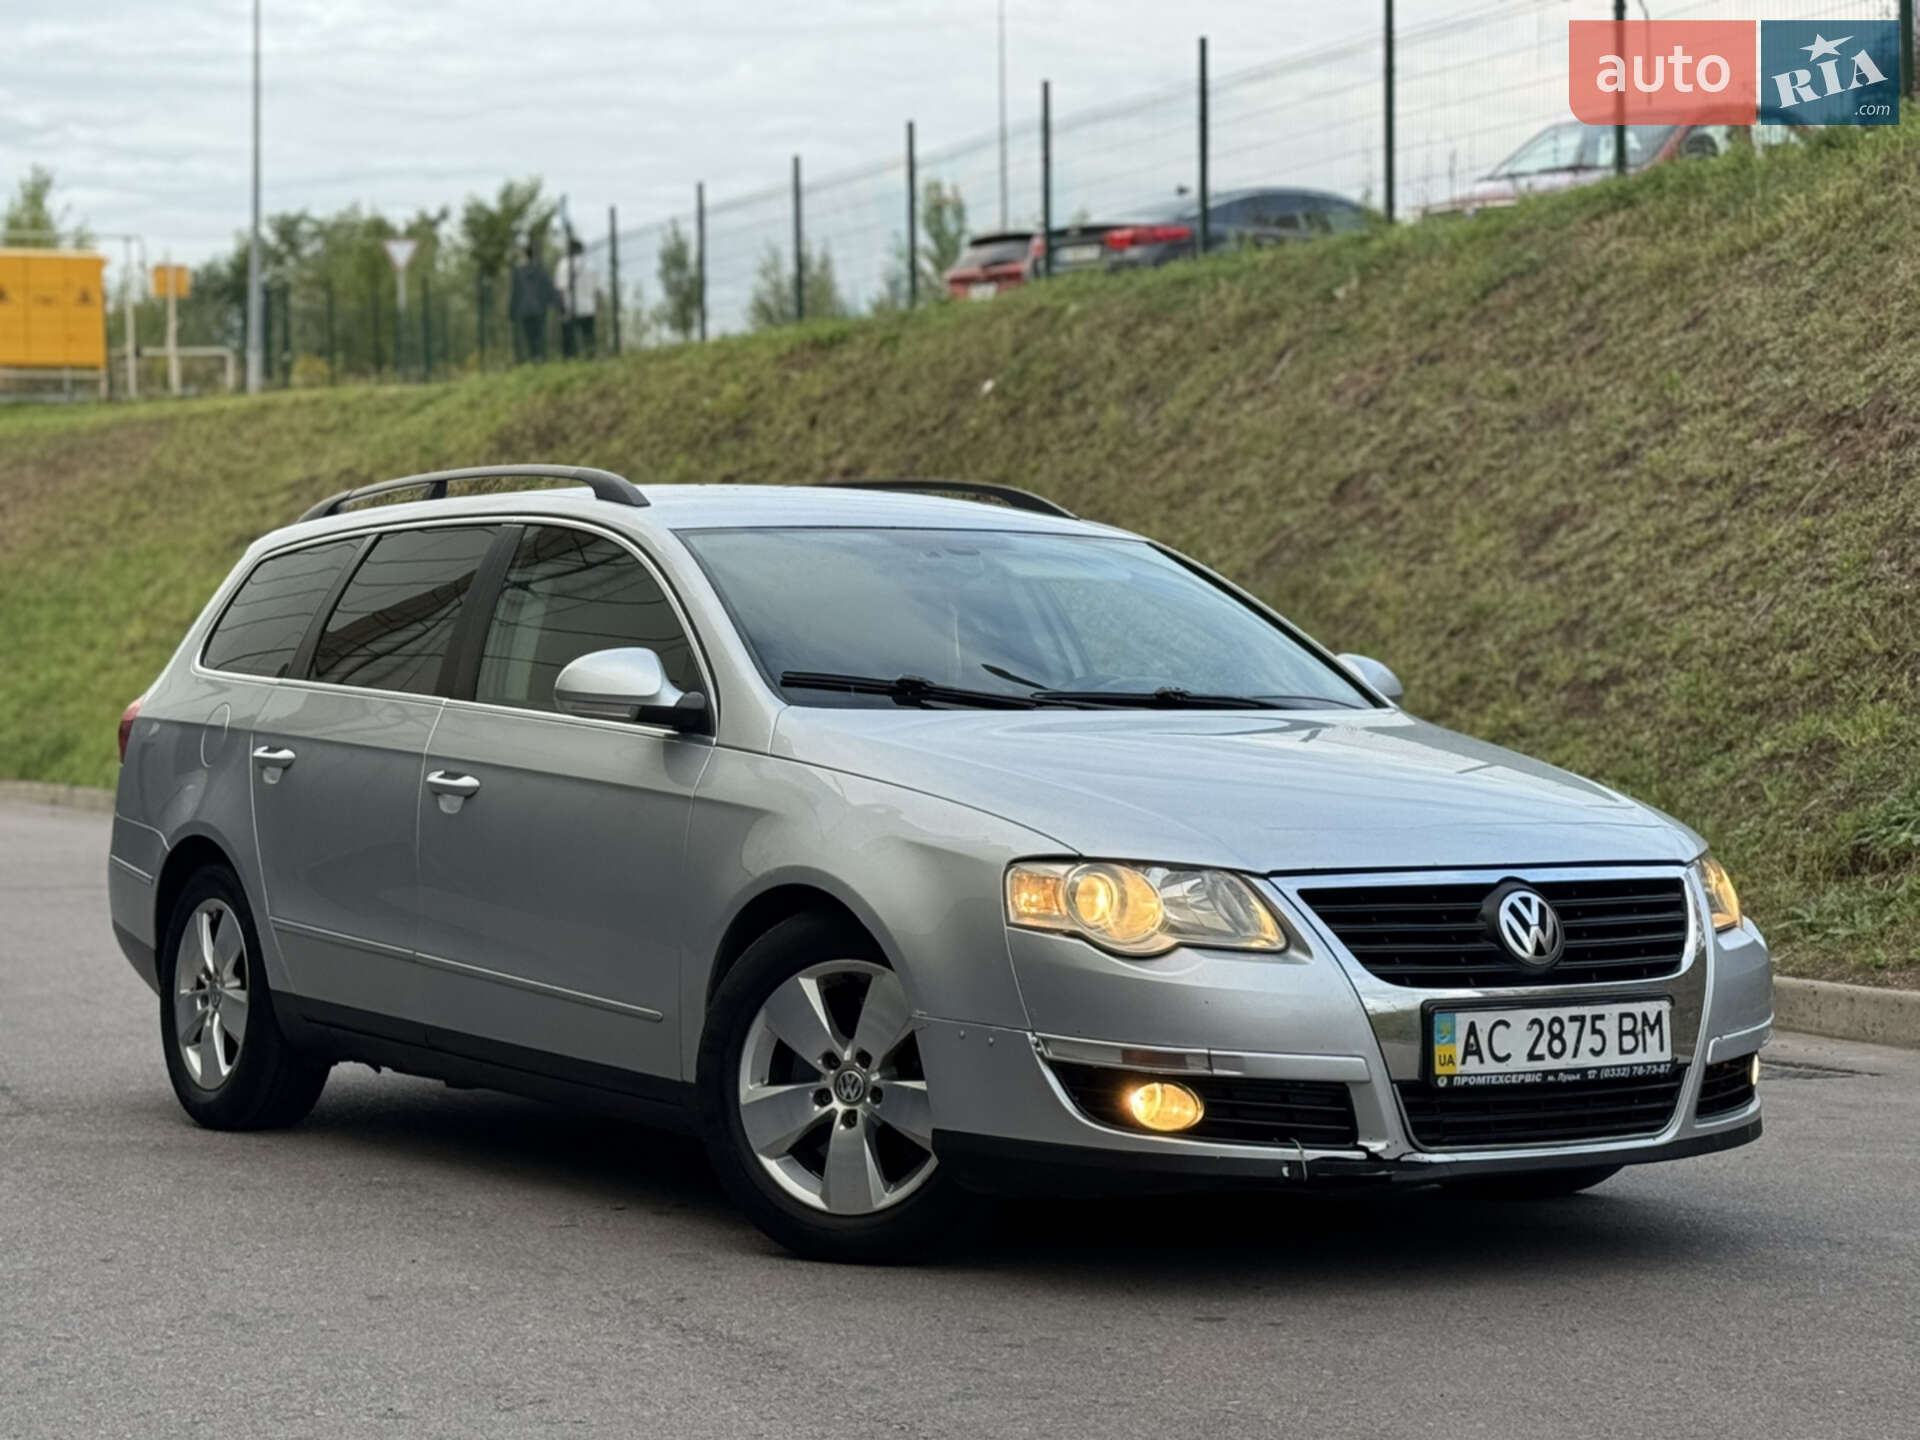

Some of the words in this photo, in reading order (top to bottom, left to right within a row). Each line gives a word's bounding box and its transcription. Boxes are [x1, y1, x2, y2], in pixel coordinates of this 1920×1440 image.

[1499, 891, 1560, 964] VW
[1438, 1053, 1455, 1067] UA
[1460, 1020, 1511, 1066] AC
[1526, 1014, 1606, 1060] 2875
[1617, 1010, 1664, 1055] BM
